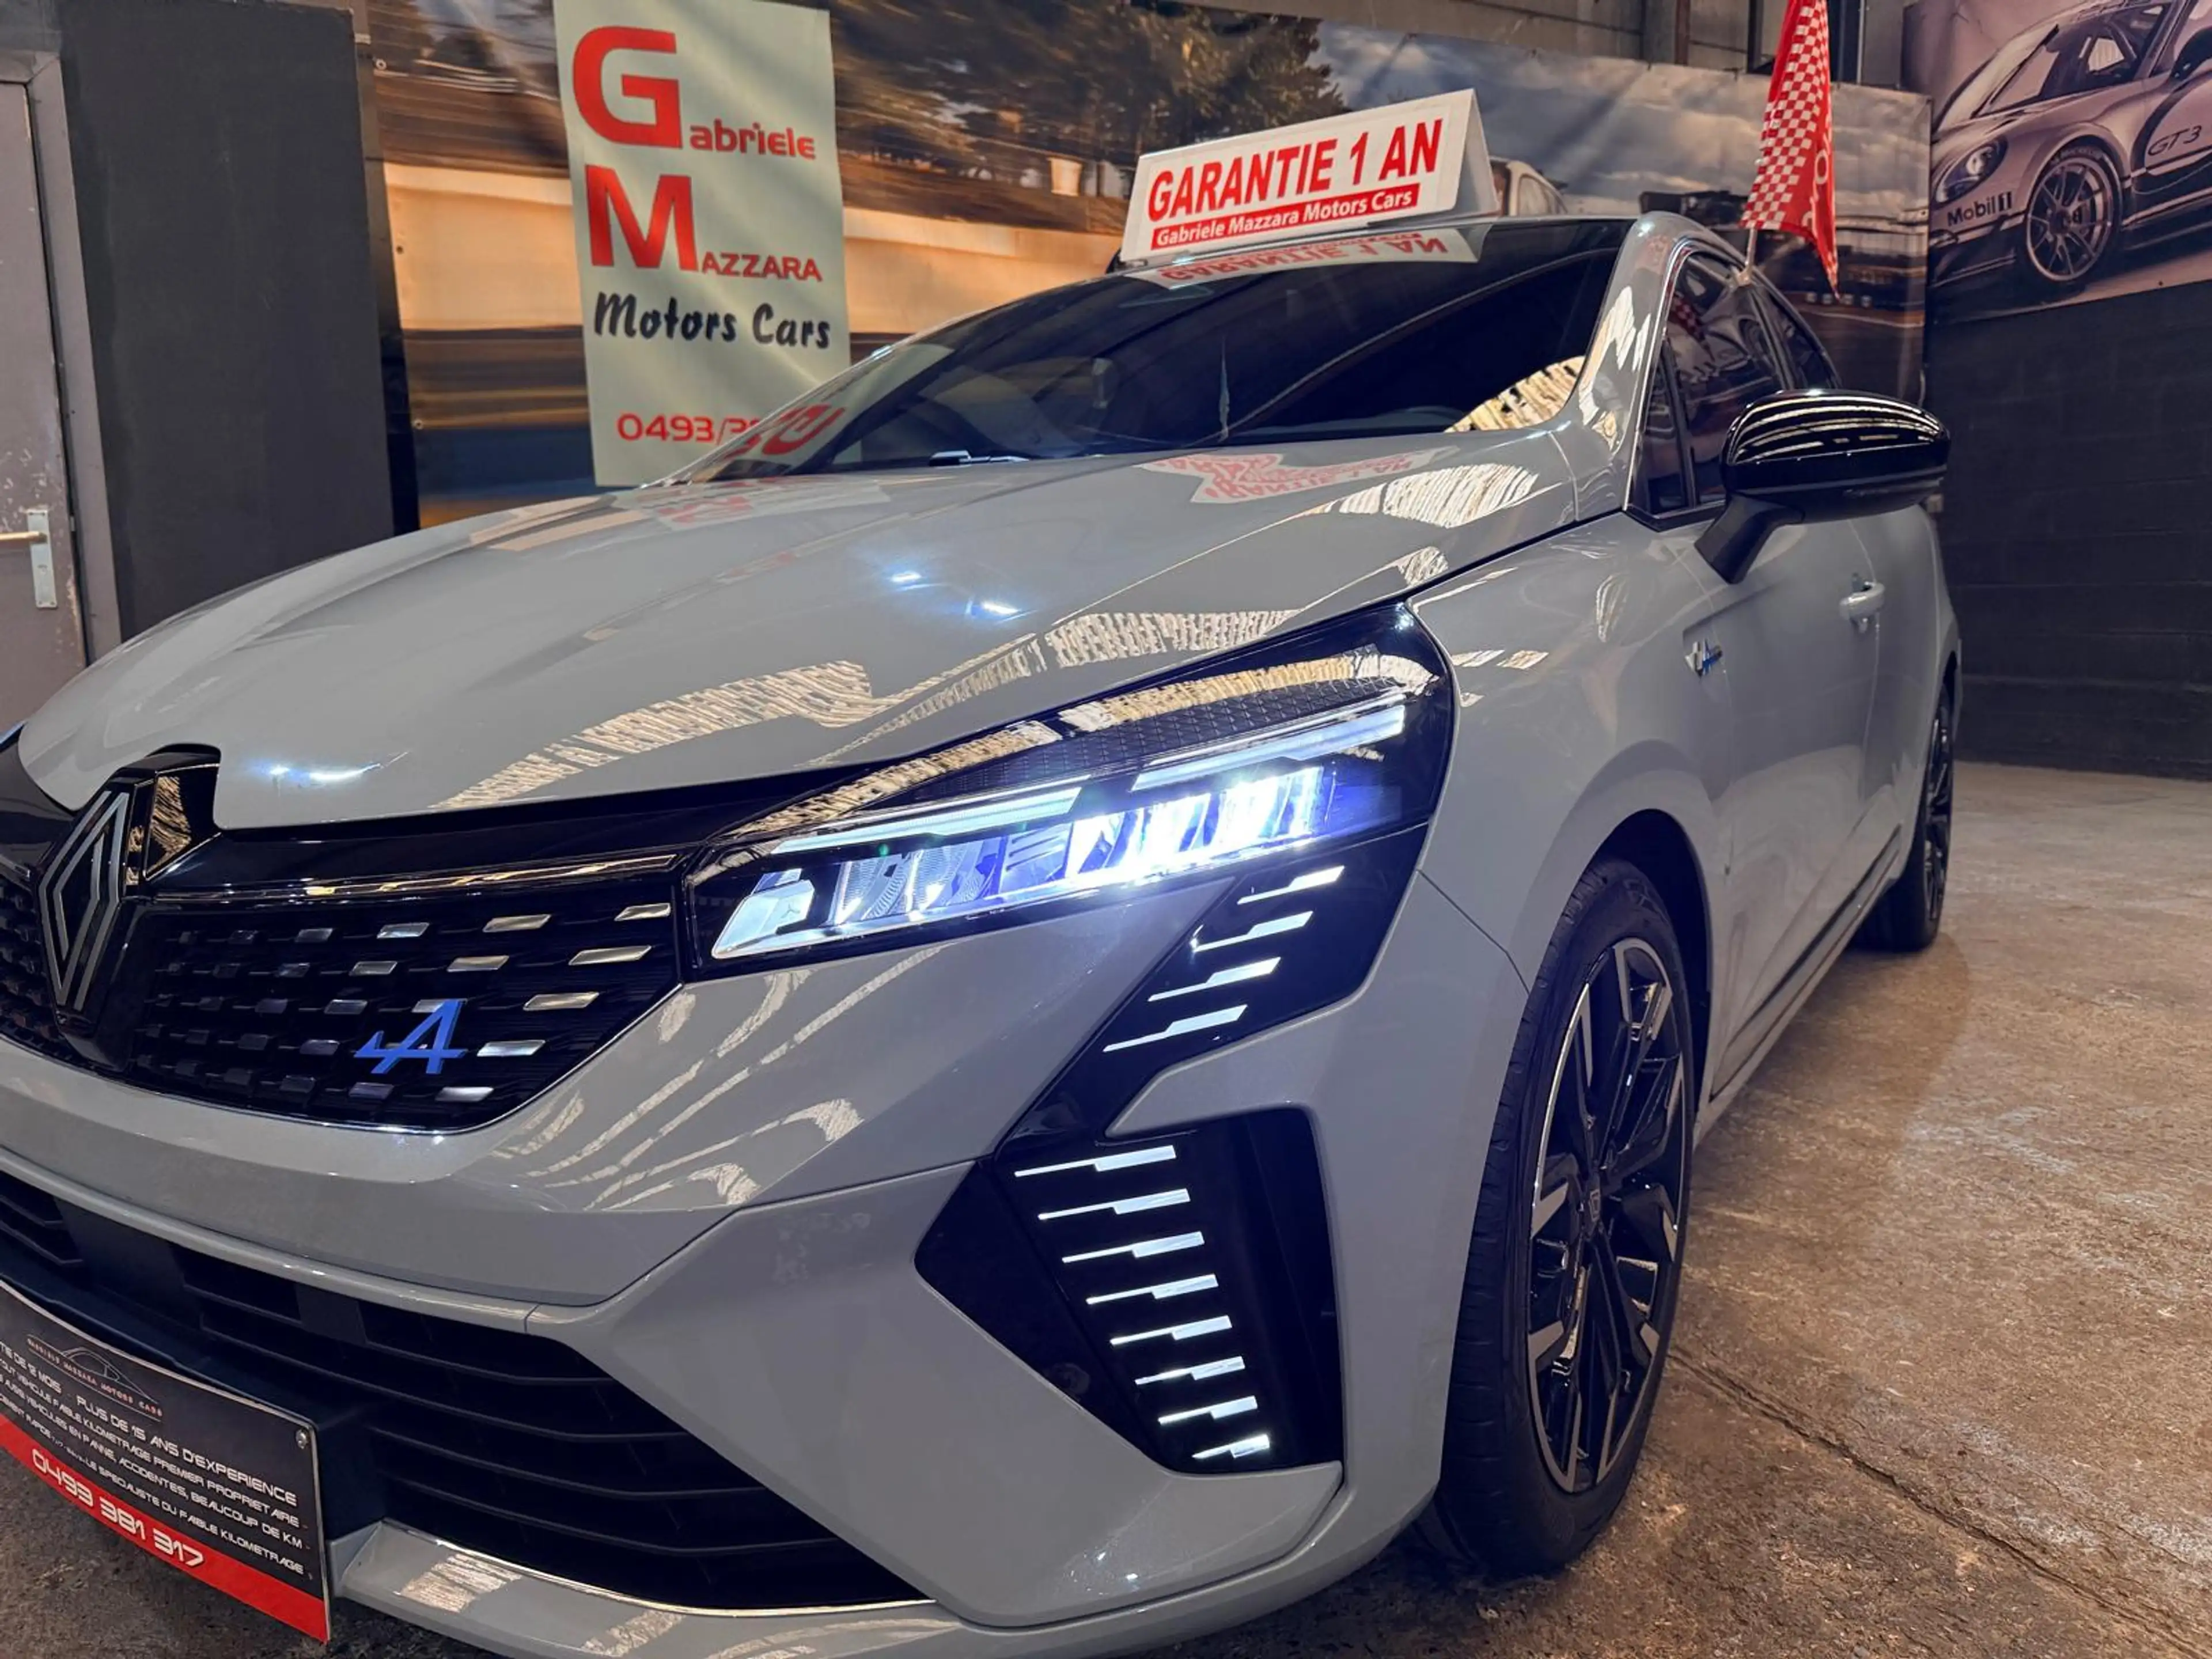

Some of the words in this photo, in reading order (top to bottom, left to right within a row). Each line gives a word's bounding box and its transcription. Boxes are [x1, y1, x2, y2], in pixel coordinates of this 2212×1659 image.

[1148, 138, 1338, 222] GARANTIE
[1350, 131, 1369, 185] 1
[1378, 118, 1443, 181] AN
[1156, 219, 1225, 247] Gabriele
[1228, 207, 1298, 235] Mazzara
[1302, 195, 1368, 224] Motors
[1371, 190, 1412, 212] Cars
[1947, 196, 1996, 227] Mobil
[594, 291, 737, 342] Motors
[752, 302, 831, 349] Cars
[76, 1395, 108, 1422] PLUS
[111, 1414, 129, 1432] DE
[131, 1425, 146, 1441] 15
[150, 1436, 179, 1457] ANS
[182, 1448, 297, 1507] D'EXPERIENCE
[83, 1416, 151, 1463] KILOMETRAGE
[153, 1456, 204, 1487] PREMIER
[32, 1448, 93, 1507] 0493
[100, 1496, 146, 1540] 381
[153, 1528, 204, 1567] 317
[161, 1501, 177, 1516] DU
[221, 1528, 304, 1575] KILOMETRAGE
[191, 1491, 258, 1527] BEAUCOUP
[262, 1522, 280, 1539] DE
[283, 1532, 302, 1549] KM
